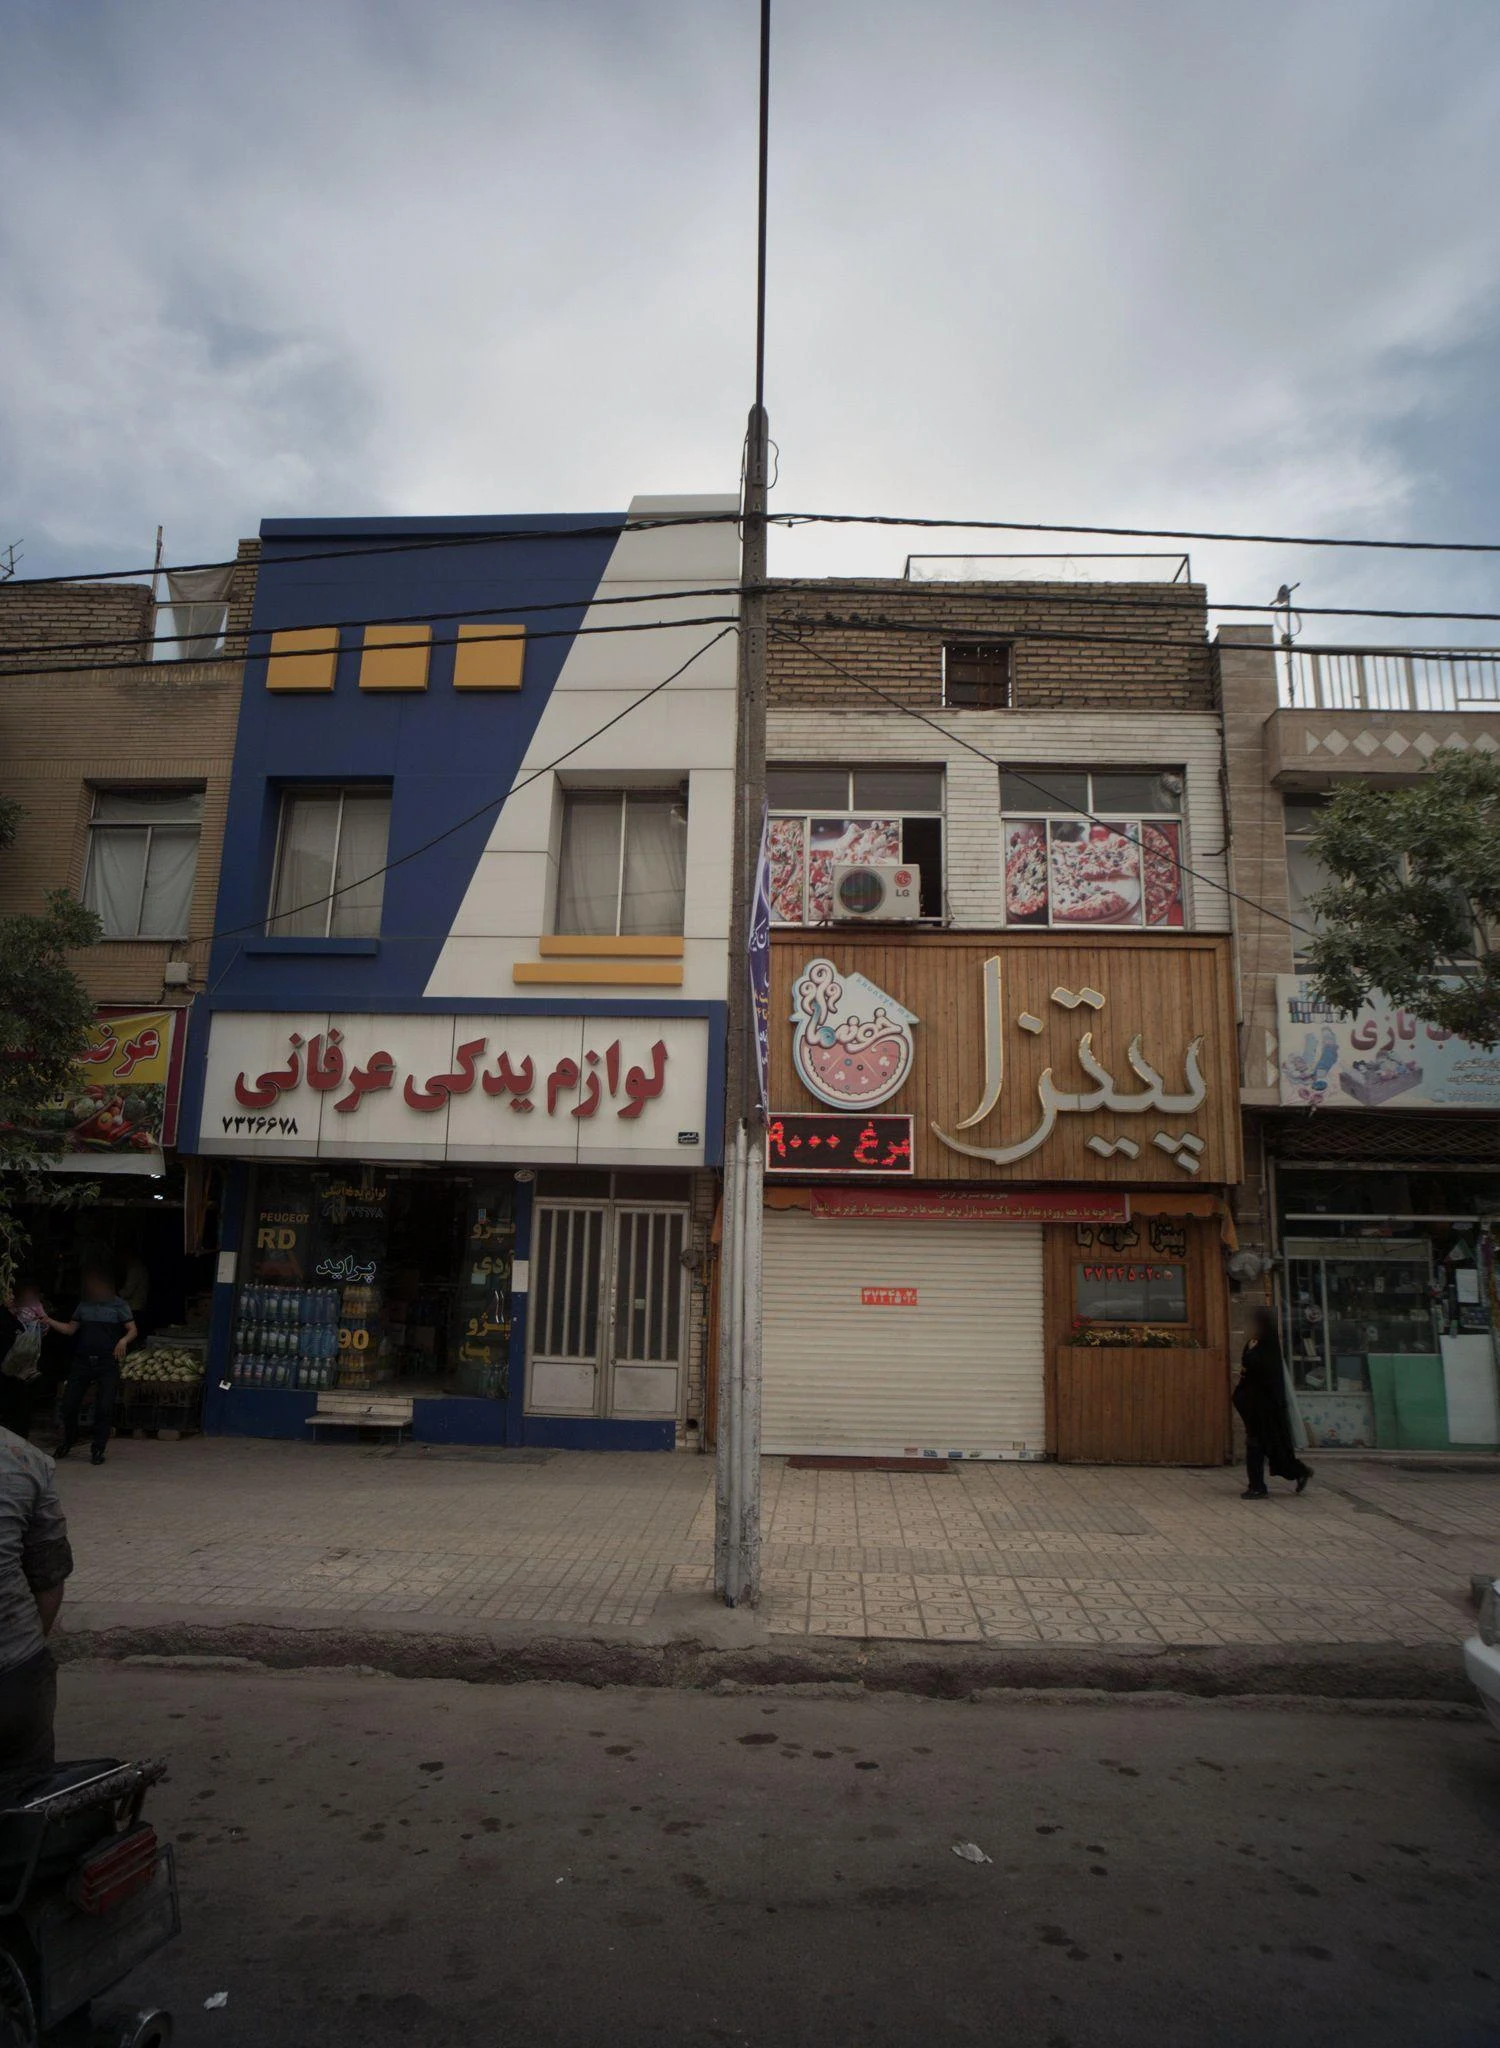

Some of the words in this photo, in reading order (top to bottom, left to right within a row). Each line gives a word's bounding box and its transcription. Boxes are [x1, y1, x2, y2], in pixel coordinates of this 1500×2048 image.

[896, 889, 910, 897] LG
[1350, 1006, 1417, 1051] بازی
[71, 1022, 161, 1078] عرض
[930, 955, 1208, 1175] پیتزا
[233, 1027, 396, 1112] عرفانی
[403, 1036, 534, 1112] یدکی
[546, 1037, 668, 1119] لوازم
[221, 1116, 299, 1135] ۷۳۲۶۶۷۸
[259, 1212, 310, 1224] PEUGEOT
[257, 1227, 297, 1250] RD
[315, 1254, 377, 1284] پراید
[338, 1327, 370, 1351] 90
